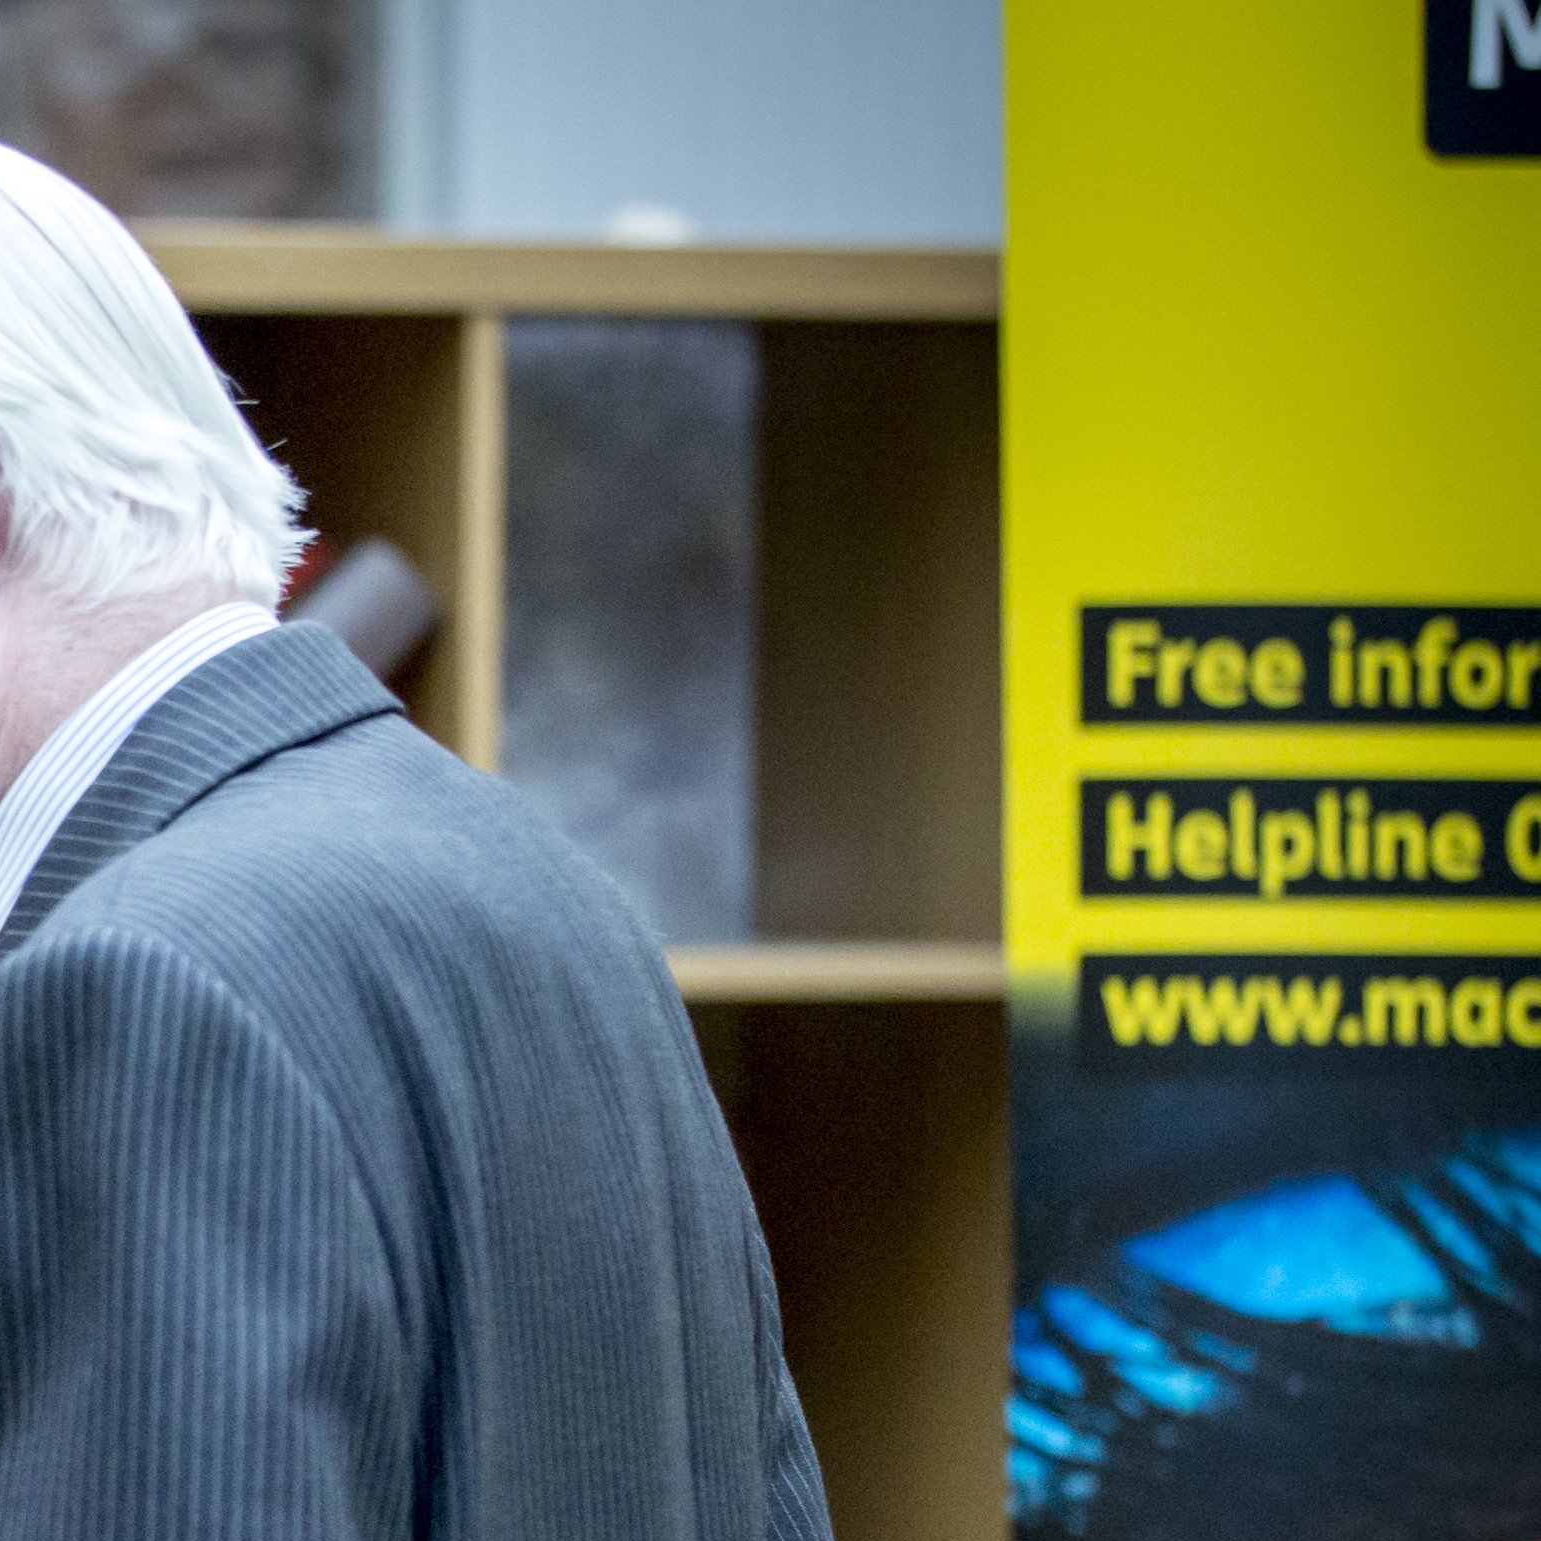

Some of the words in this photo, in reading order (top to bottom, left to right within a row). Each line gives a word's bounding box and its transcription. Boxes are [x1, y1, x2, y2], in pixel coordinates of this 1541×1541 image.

[1107, 617, 1305, 709] Free
[1328, 615, 1541, 710] infor
[1106, 786, 1483, 899] Helpline
